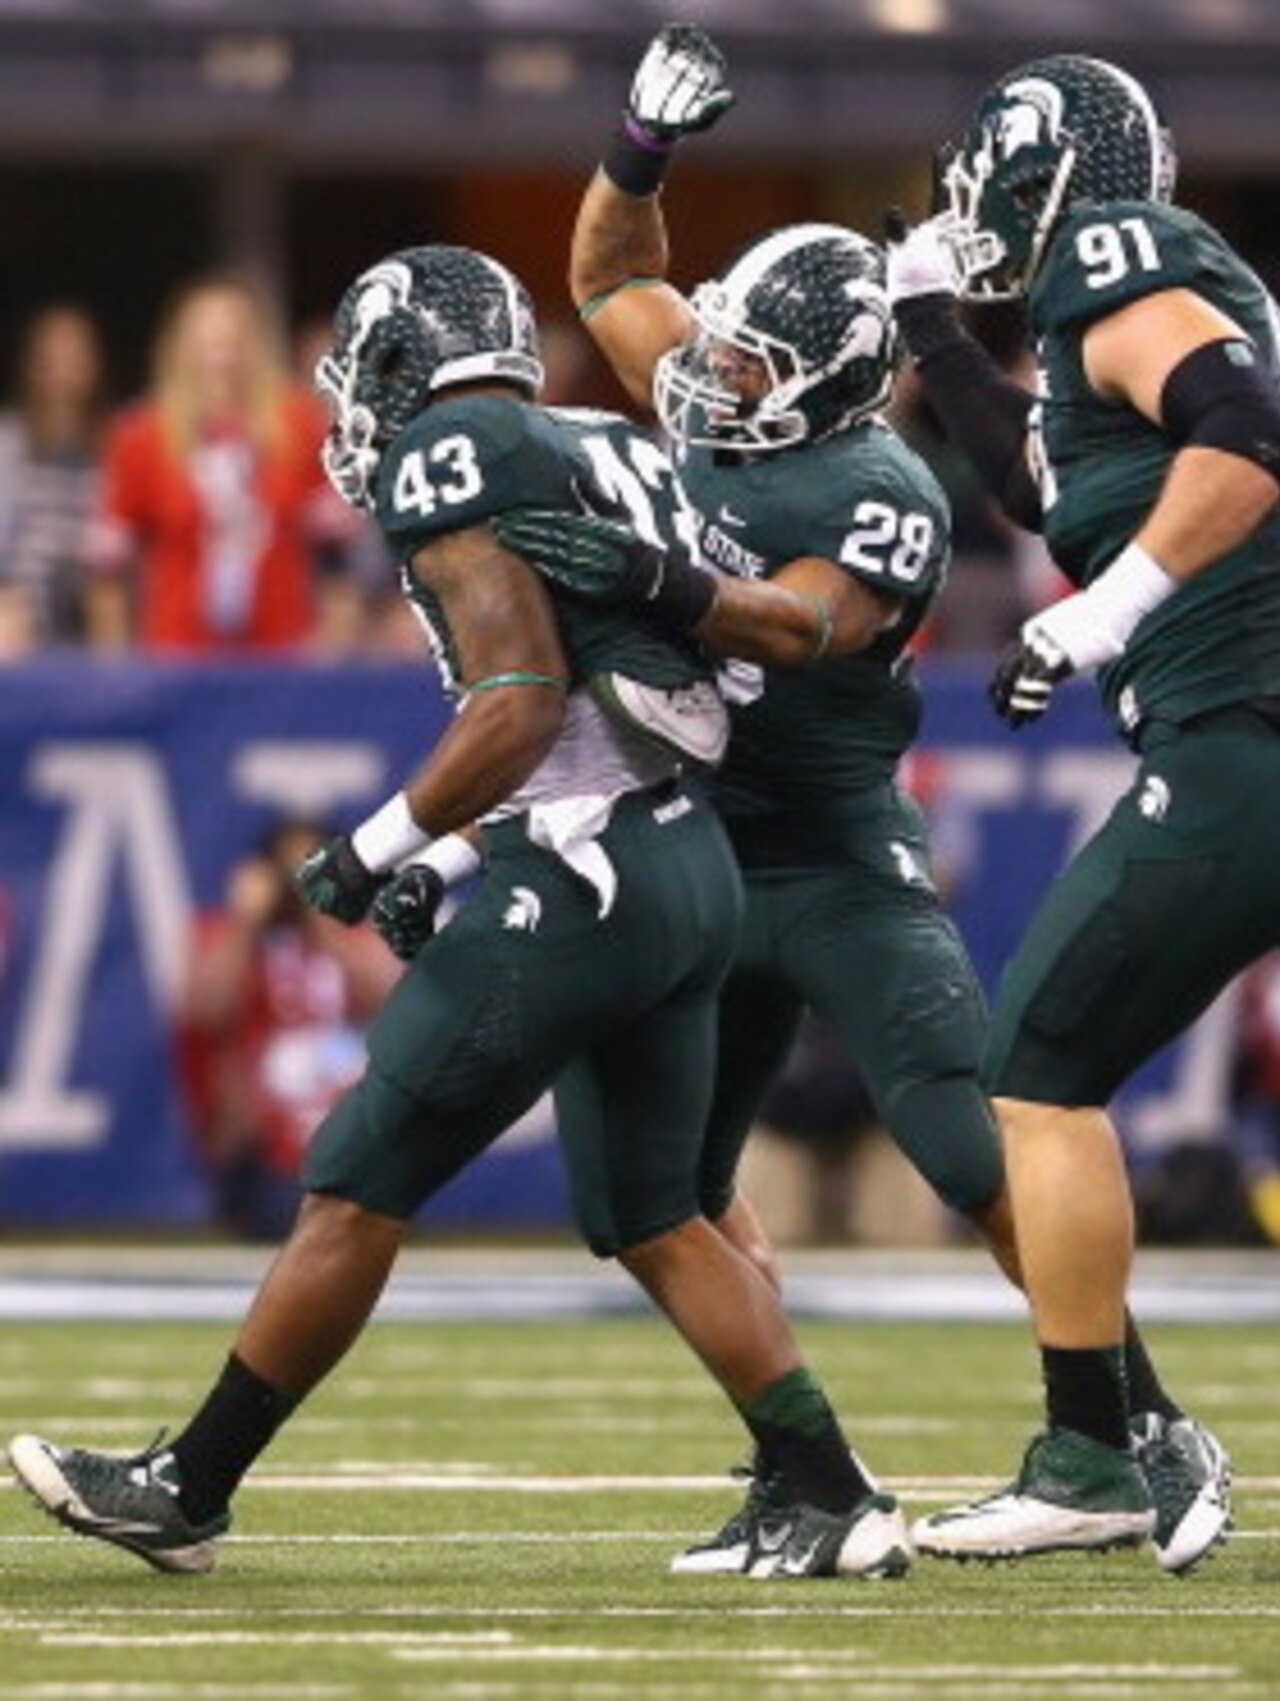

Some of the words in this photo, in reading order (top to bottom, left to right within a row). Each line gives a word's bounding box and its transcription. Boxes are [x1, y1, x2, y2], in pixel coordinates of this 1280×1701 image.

[1074, 219, 1161, 289] 91
[393, 433, 485, 517] 43
[840, 501, 933, 581] 28
